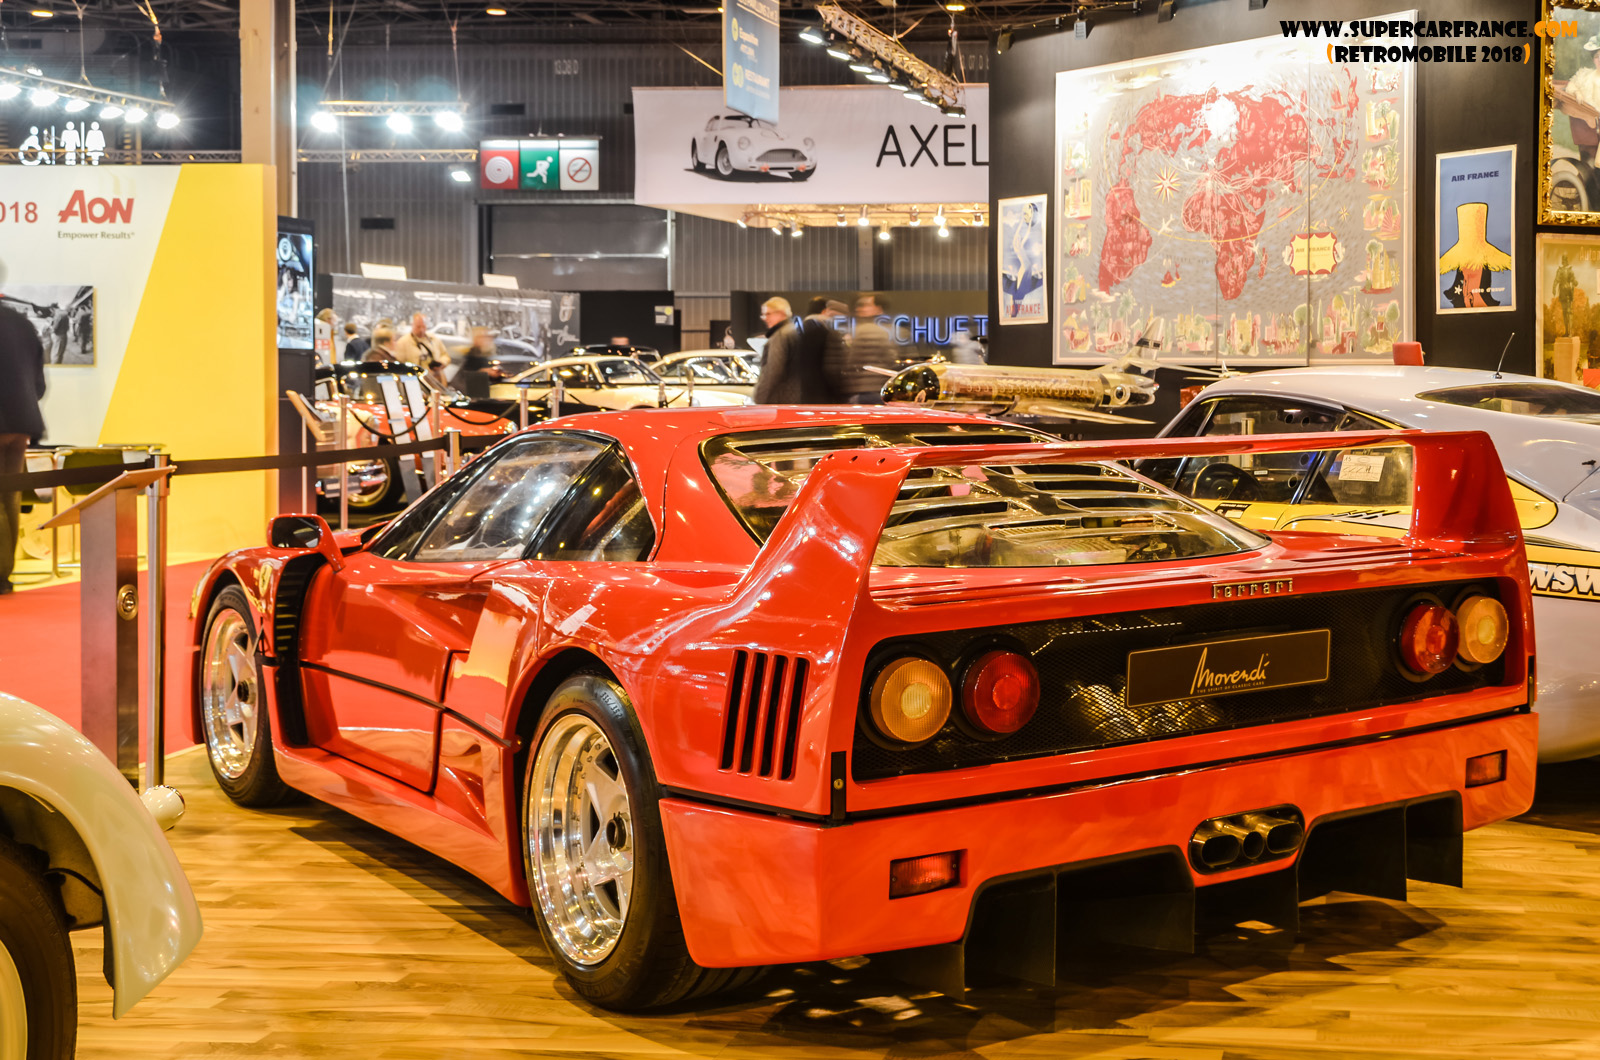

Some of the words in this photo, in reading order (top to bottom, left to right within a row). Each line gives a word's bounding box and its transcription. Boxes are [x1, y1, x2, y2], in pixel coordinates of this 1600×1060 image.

[876, 124, 989, 168] AXEL
[1451, 174, 1466, 182] AIR
[1467, 170, 1500, 180] FRANCE
[57, 231, 98, 240] Empower
[1212, 578, 1294, 599] Ferrari
